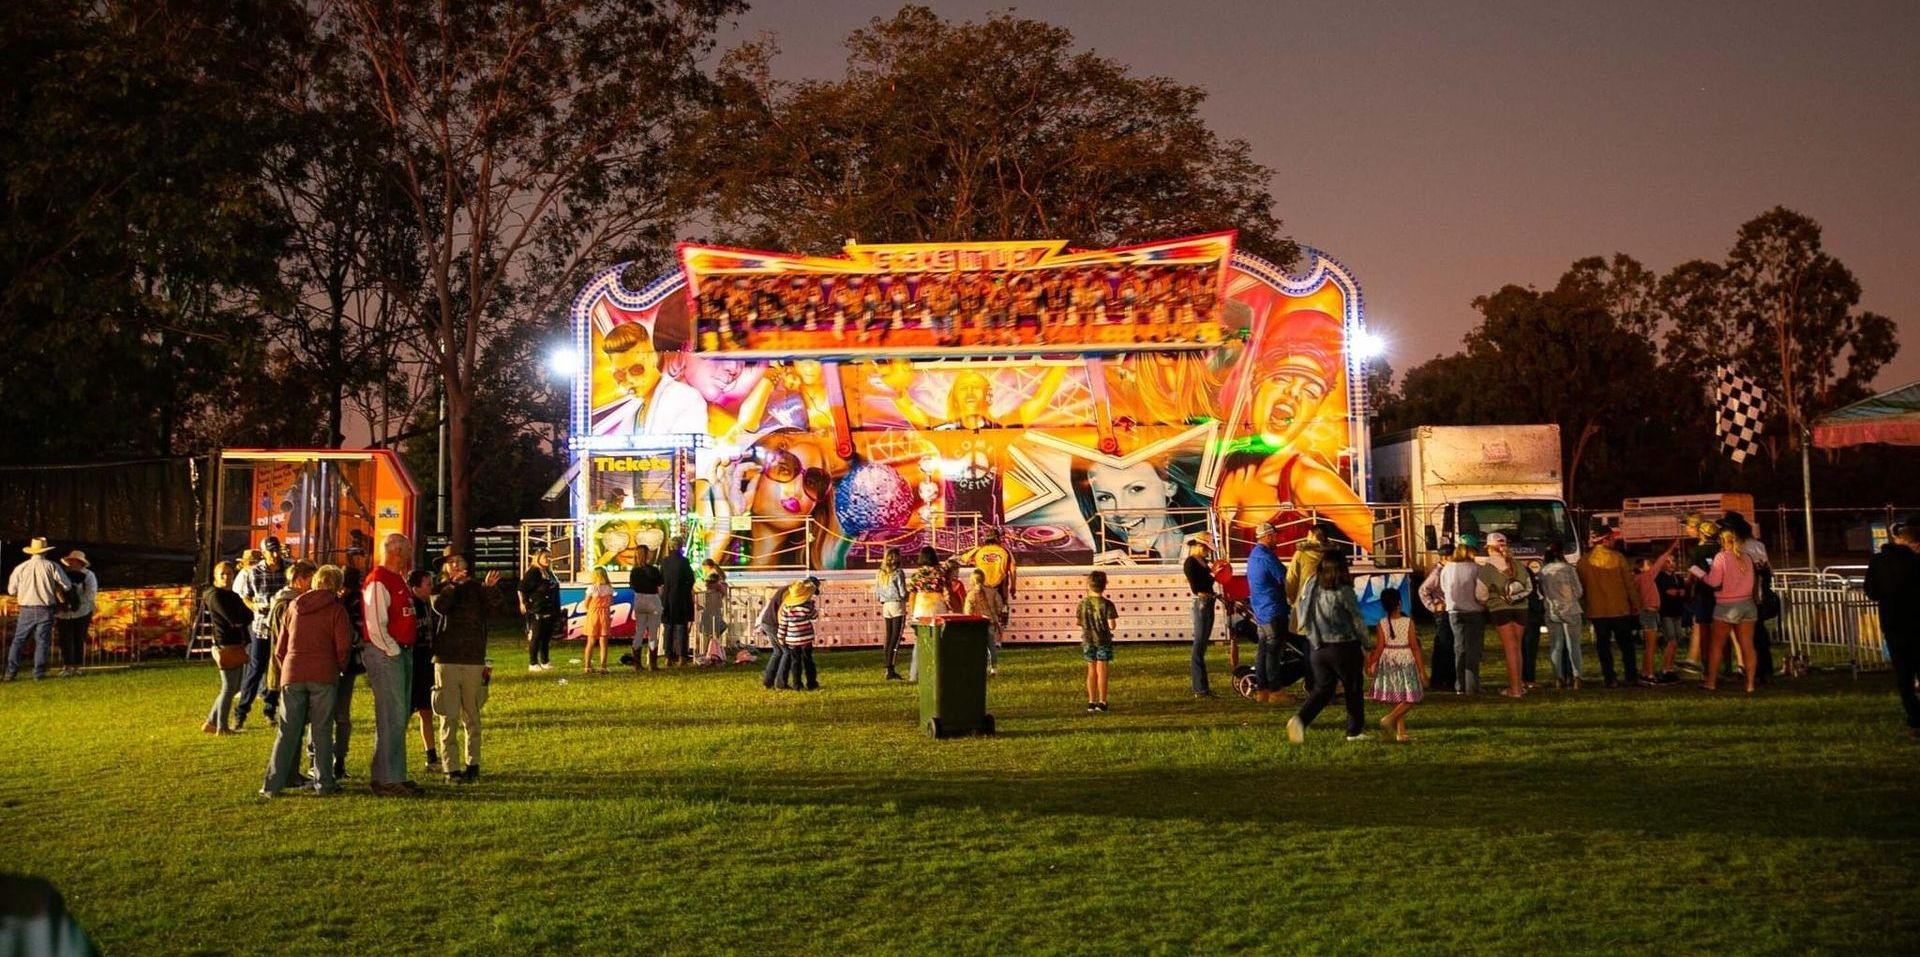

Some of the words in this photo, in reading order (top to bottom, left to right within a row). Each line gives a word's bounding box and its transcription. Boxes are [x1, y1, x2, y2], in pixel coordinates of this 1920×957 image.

[954, 439, 995, 457] COME
[594, 457, 671, 472] Tickets
[954, 467, 997, 490] GETHE
